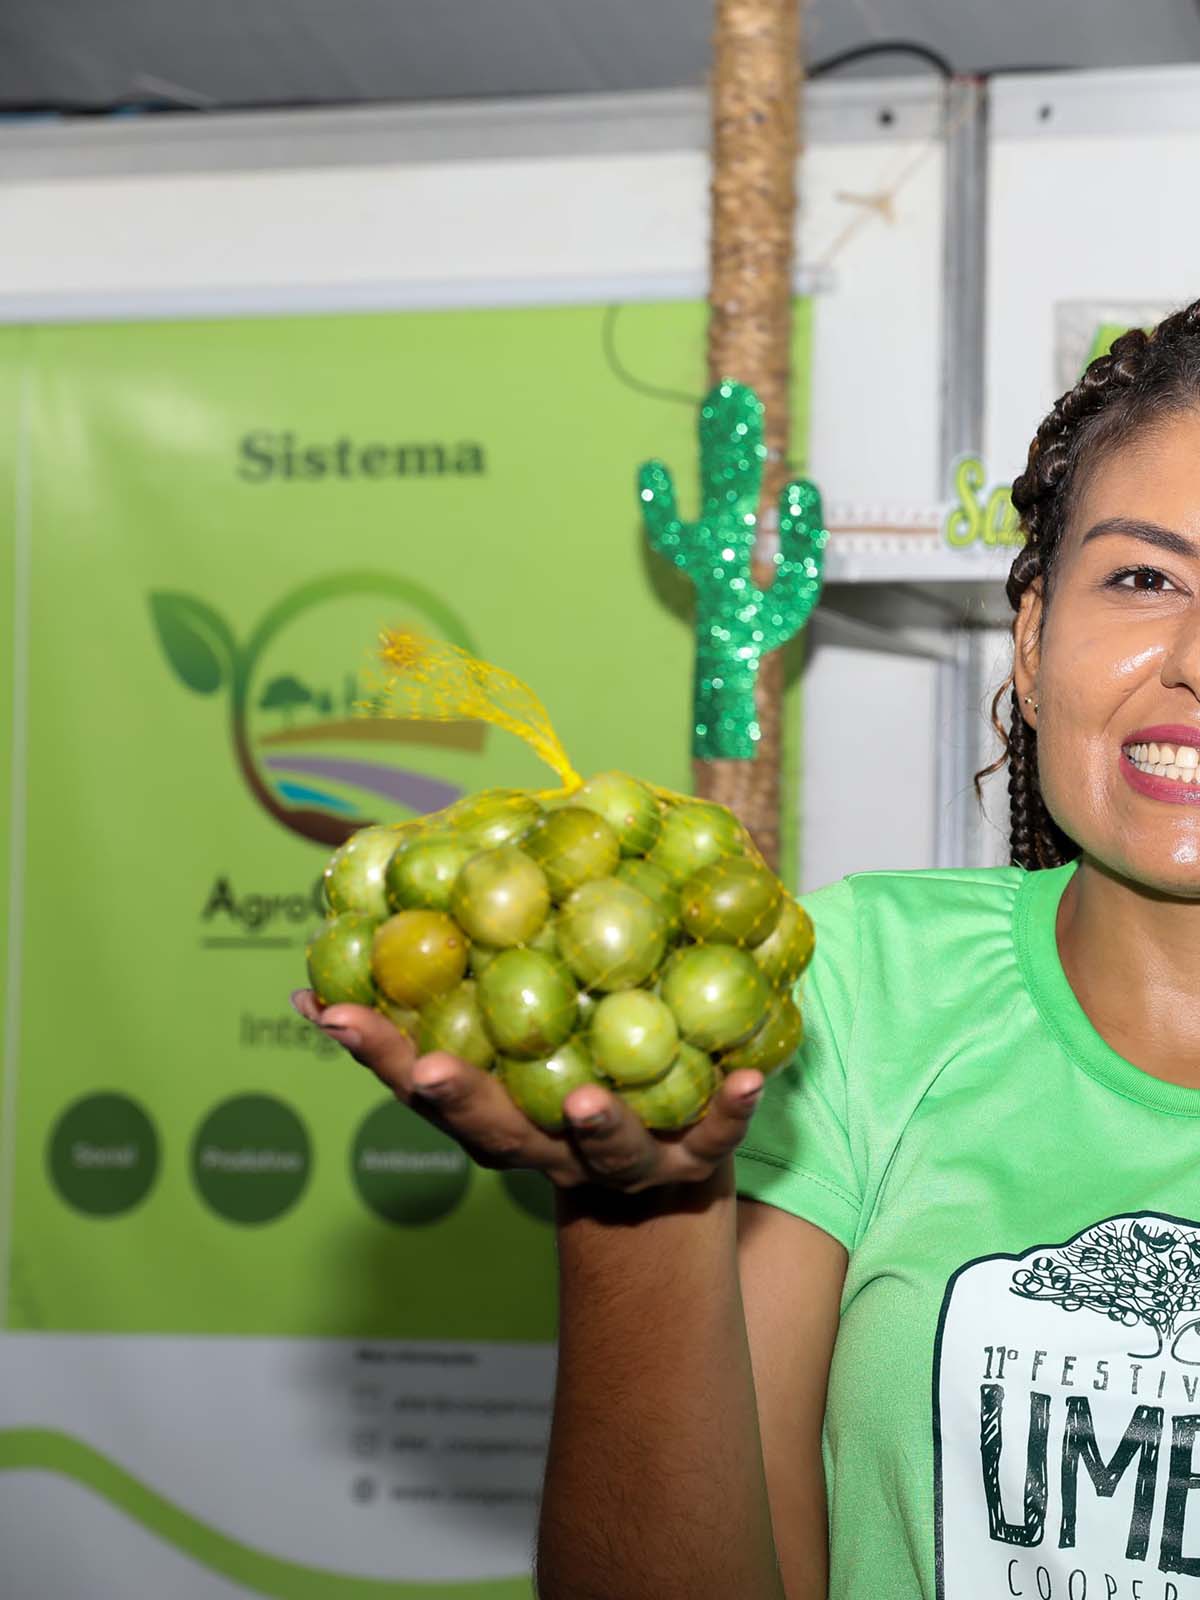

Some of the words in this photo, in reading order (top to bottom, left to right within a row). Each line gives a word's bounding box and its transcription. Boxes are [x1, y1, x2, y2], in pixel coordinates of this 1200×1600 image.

[237, 429, 486, 481] Sistema
[945, 457, 1028, 548] Sa
[241, 1012, 341, 1061] Integ
